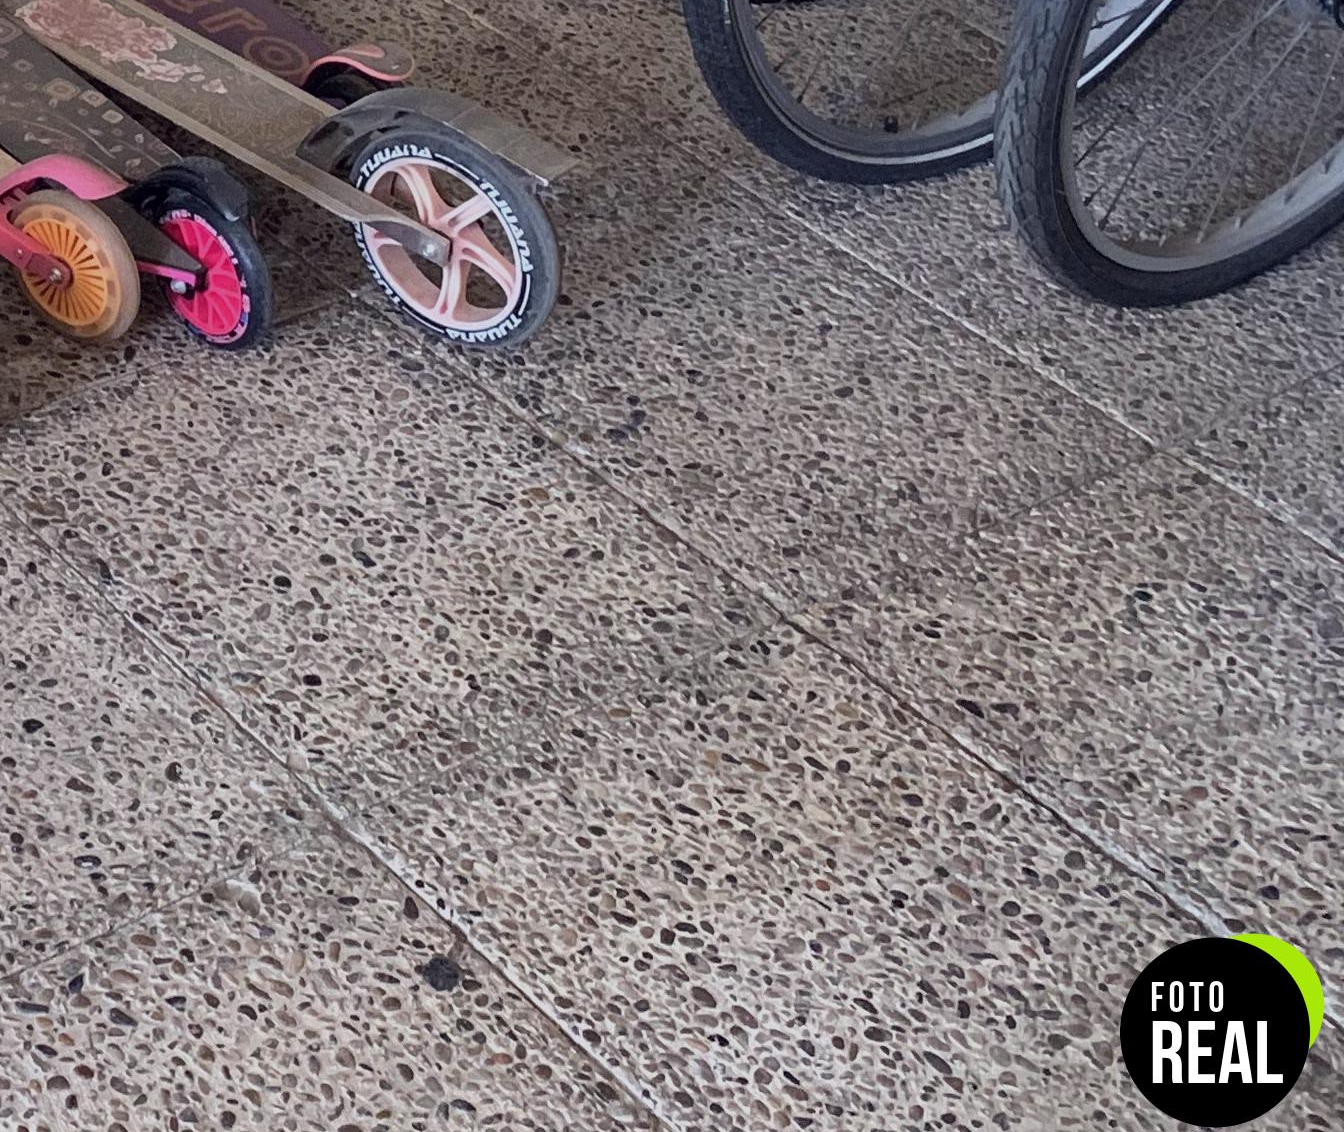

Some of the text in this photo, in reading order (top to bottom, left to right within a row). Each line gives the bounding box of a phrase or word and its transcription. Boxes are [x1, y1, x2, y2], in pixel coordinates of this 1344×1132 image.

[360, 144, 433, 178] TIJUANA
[478, 179, 534, 273] TIJUANA
[445, 313, 523, 344] TIJUANA
